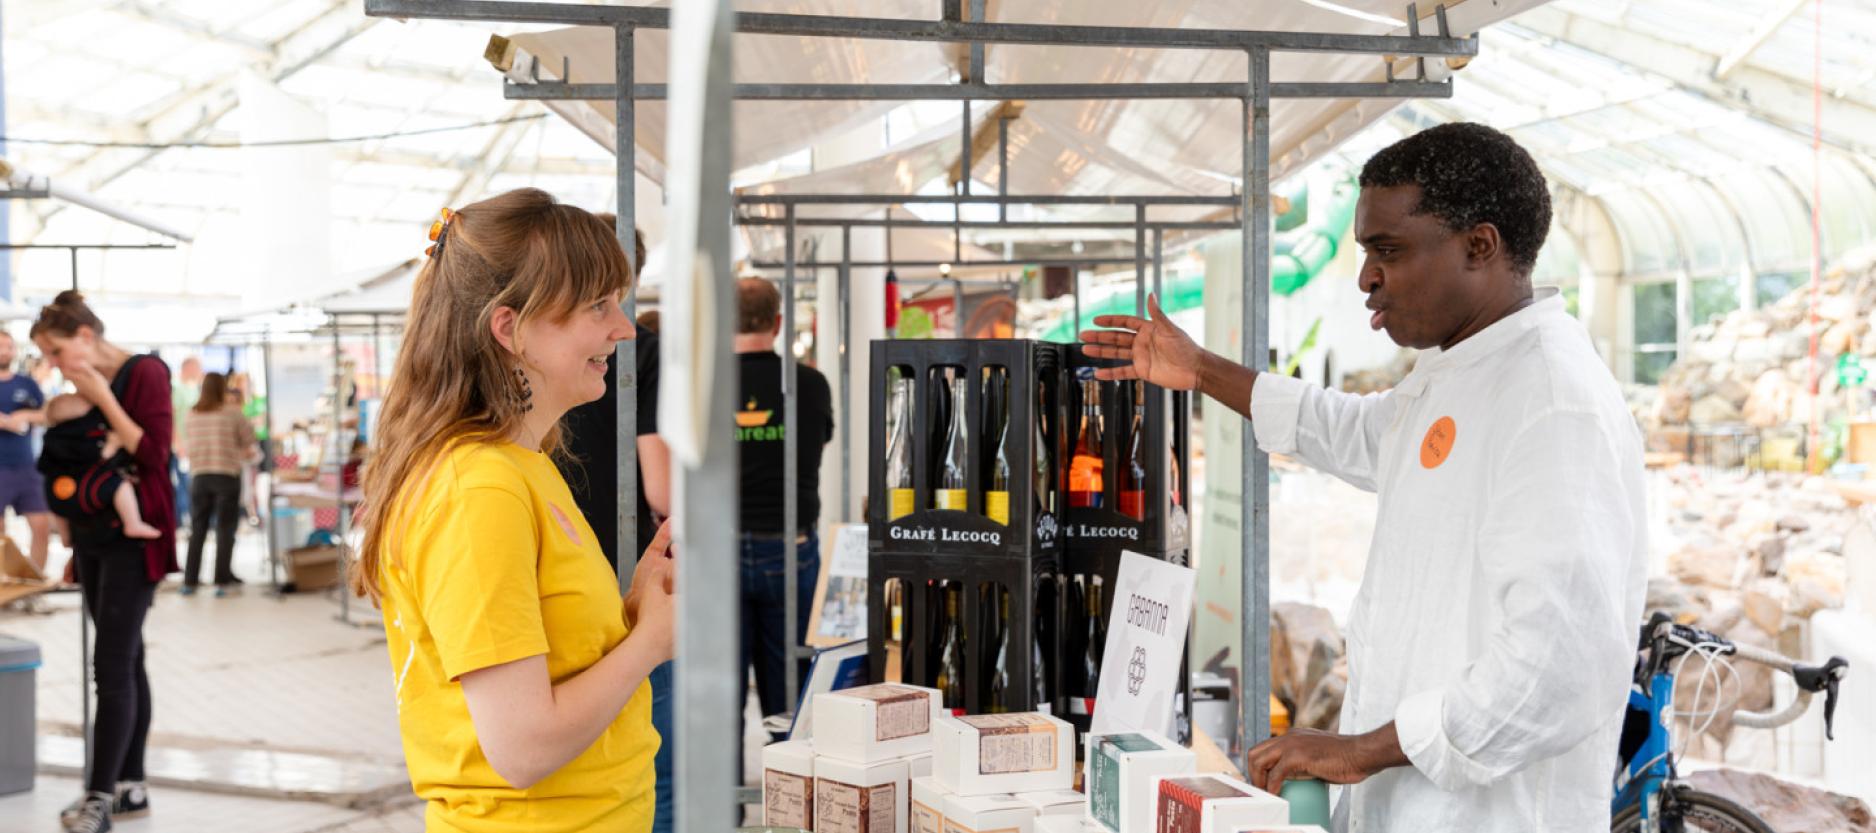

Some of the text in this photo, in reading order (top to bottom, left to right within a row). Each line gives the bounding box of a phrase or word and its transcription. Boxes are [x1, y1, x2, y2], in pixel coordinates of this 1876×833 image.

[890, 526, 1001, 546] GRAFÉ LECOCQ
[1081, 525, 1138, 540] LECOCQ
[1127, 594, 1168, 637] GABANNA
